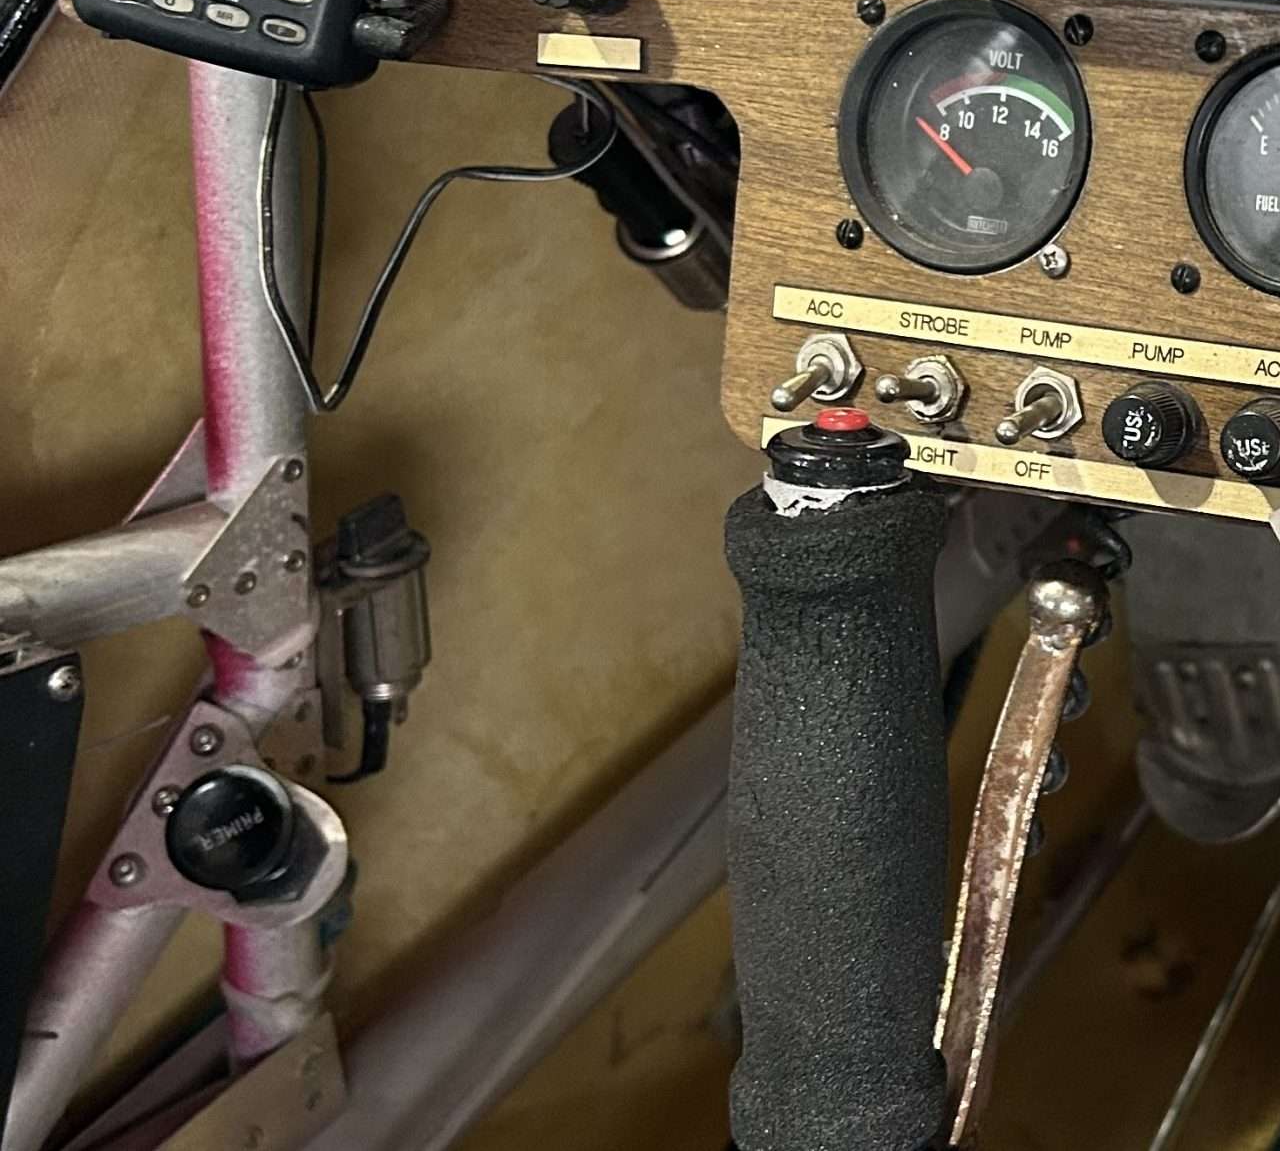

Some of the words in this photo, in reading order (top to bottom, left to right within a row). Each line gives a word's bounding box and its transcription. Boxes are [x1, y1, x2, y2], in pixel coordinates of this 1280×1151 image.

[989, 50, 1024, 70] VOLT
[958, 111, 975, 129] 10
[992, 106, 1008, 124] 12
[939, 123, 950, 141] 8
[1024, 120, 1041, 139] 14
[1041, 139, 1058, 157] 16
[1261, 135, 1268, 155] E
[1256, 195, 1280, 212] FUEL
[806, 299, 844, 319] ACC
[900, 312, 970, 335] STROBE
[1020, 328, 1072, 349] PUMP
[1132, 342, 1185, 364] PUMP
[1015, 461, 1051, 480] OFF
